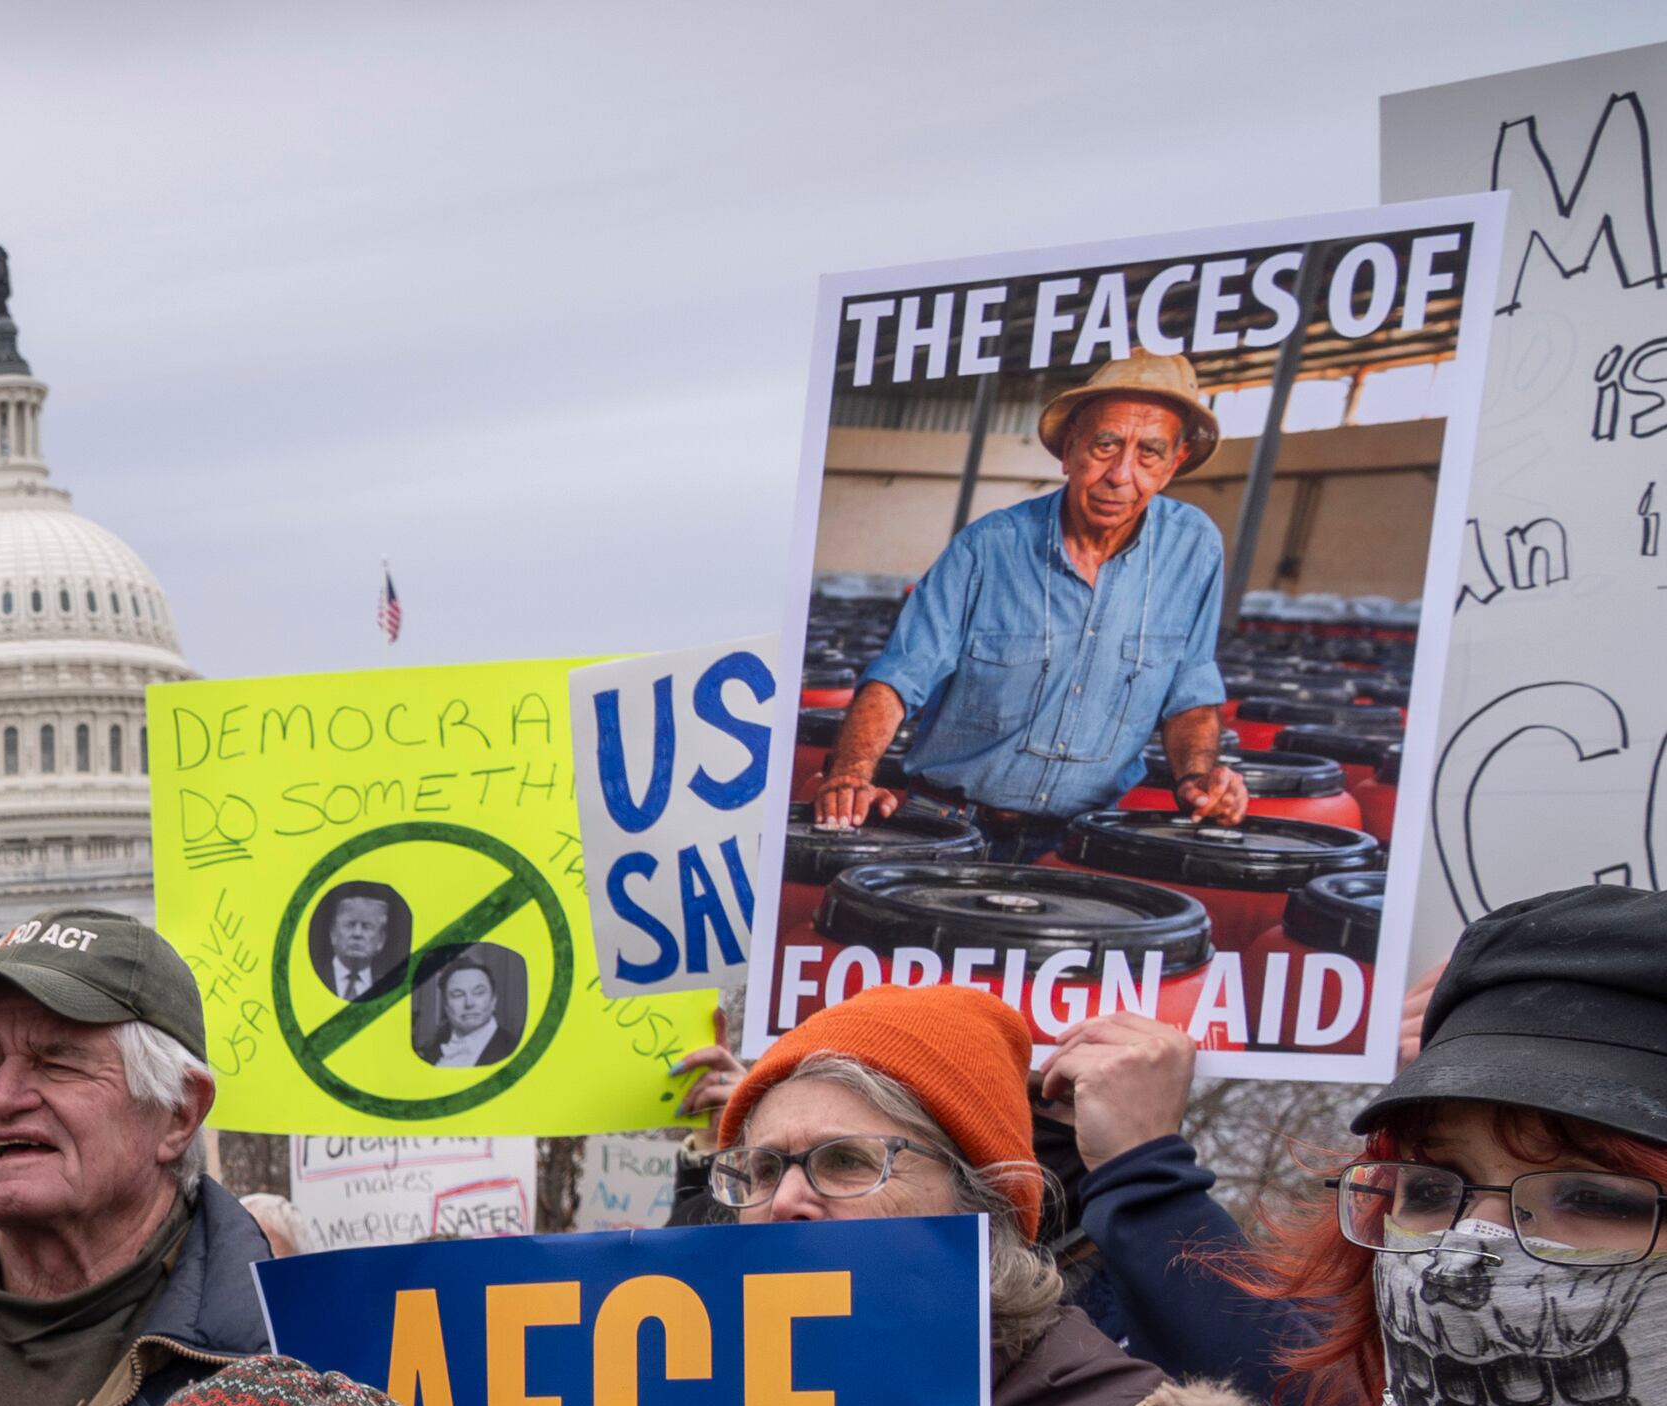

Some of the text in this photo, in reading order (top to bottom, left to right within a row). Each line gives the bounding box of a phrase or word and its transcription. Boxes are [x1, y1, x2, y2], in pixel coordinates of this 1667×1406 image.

[845, 233, 1461, 387] THE FACES OF
[179, 788, 258, 844] DO
[38, 922, 98, 951] ACT
[204, 939, 260, 1013] THE
[1193, 951, 1367, 1056] AID
[208, 999, 272, 1077] USA
[311, 1202, 524, 1250] AMERICA SAFER
